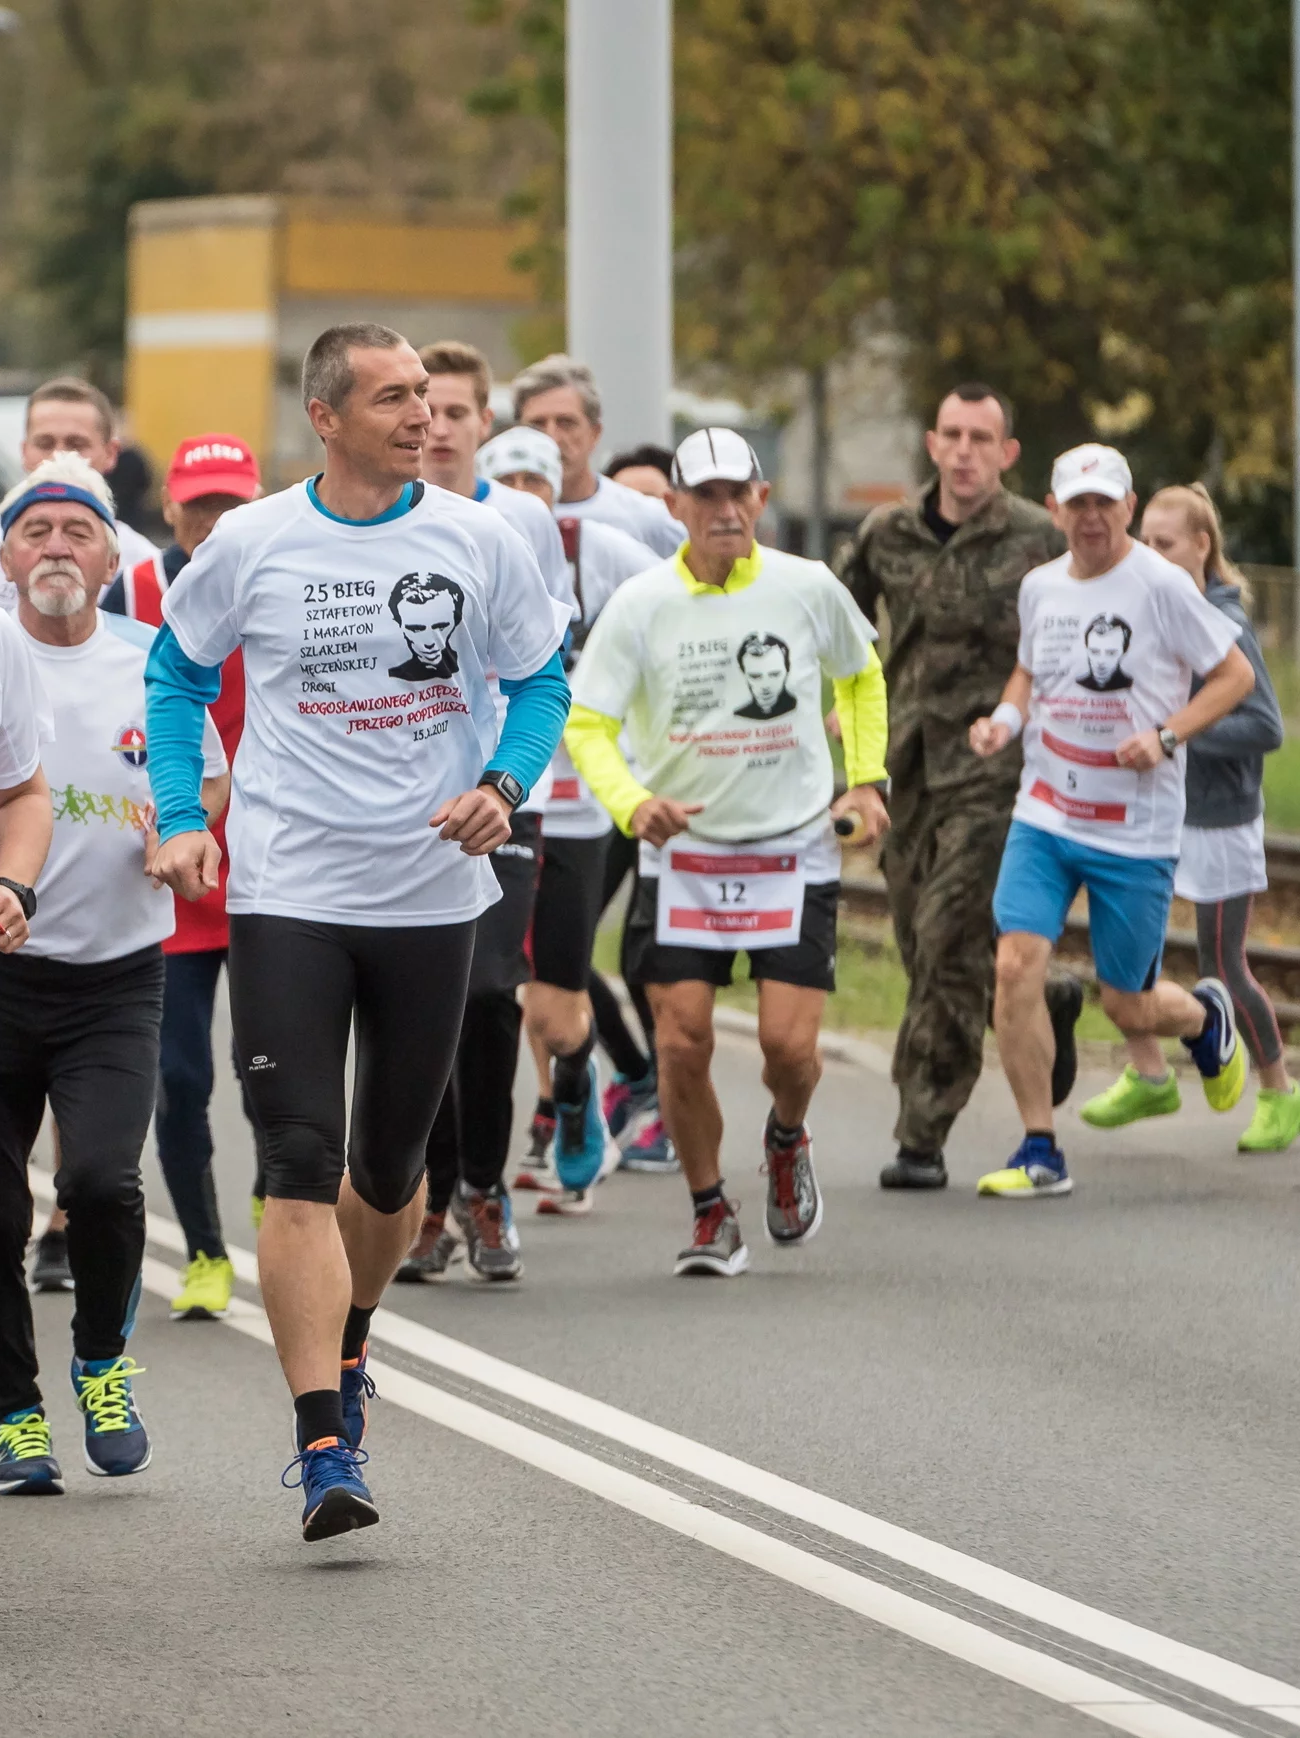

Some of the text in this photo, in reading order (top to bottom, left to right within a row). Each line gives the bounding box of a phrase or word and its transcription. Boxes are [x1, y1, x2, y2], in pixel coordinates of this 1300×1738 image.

[304, 580, 375, 603] 25 BIEG
[306, 603, 383, 622] SZTAFETOWY
[304, 622, 374, 641] I MARATON
[300, 641, 358, 659] SZLAKIEM
[679, 641, 695, 657] 25
[300, 656, 377, 677] MĘCZEŃSKIEJ
[302, 681, 336, 693] DROGI
[298, 692, 415, 716] BŁOGOSŁAWIONEGO
[346, 715, 403, 735] JERZEGO
[1067, 770, 1077, 791] 5
[718, 882, 746, 904] 12
